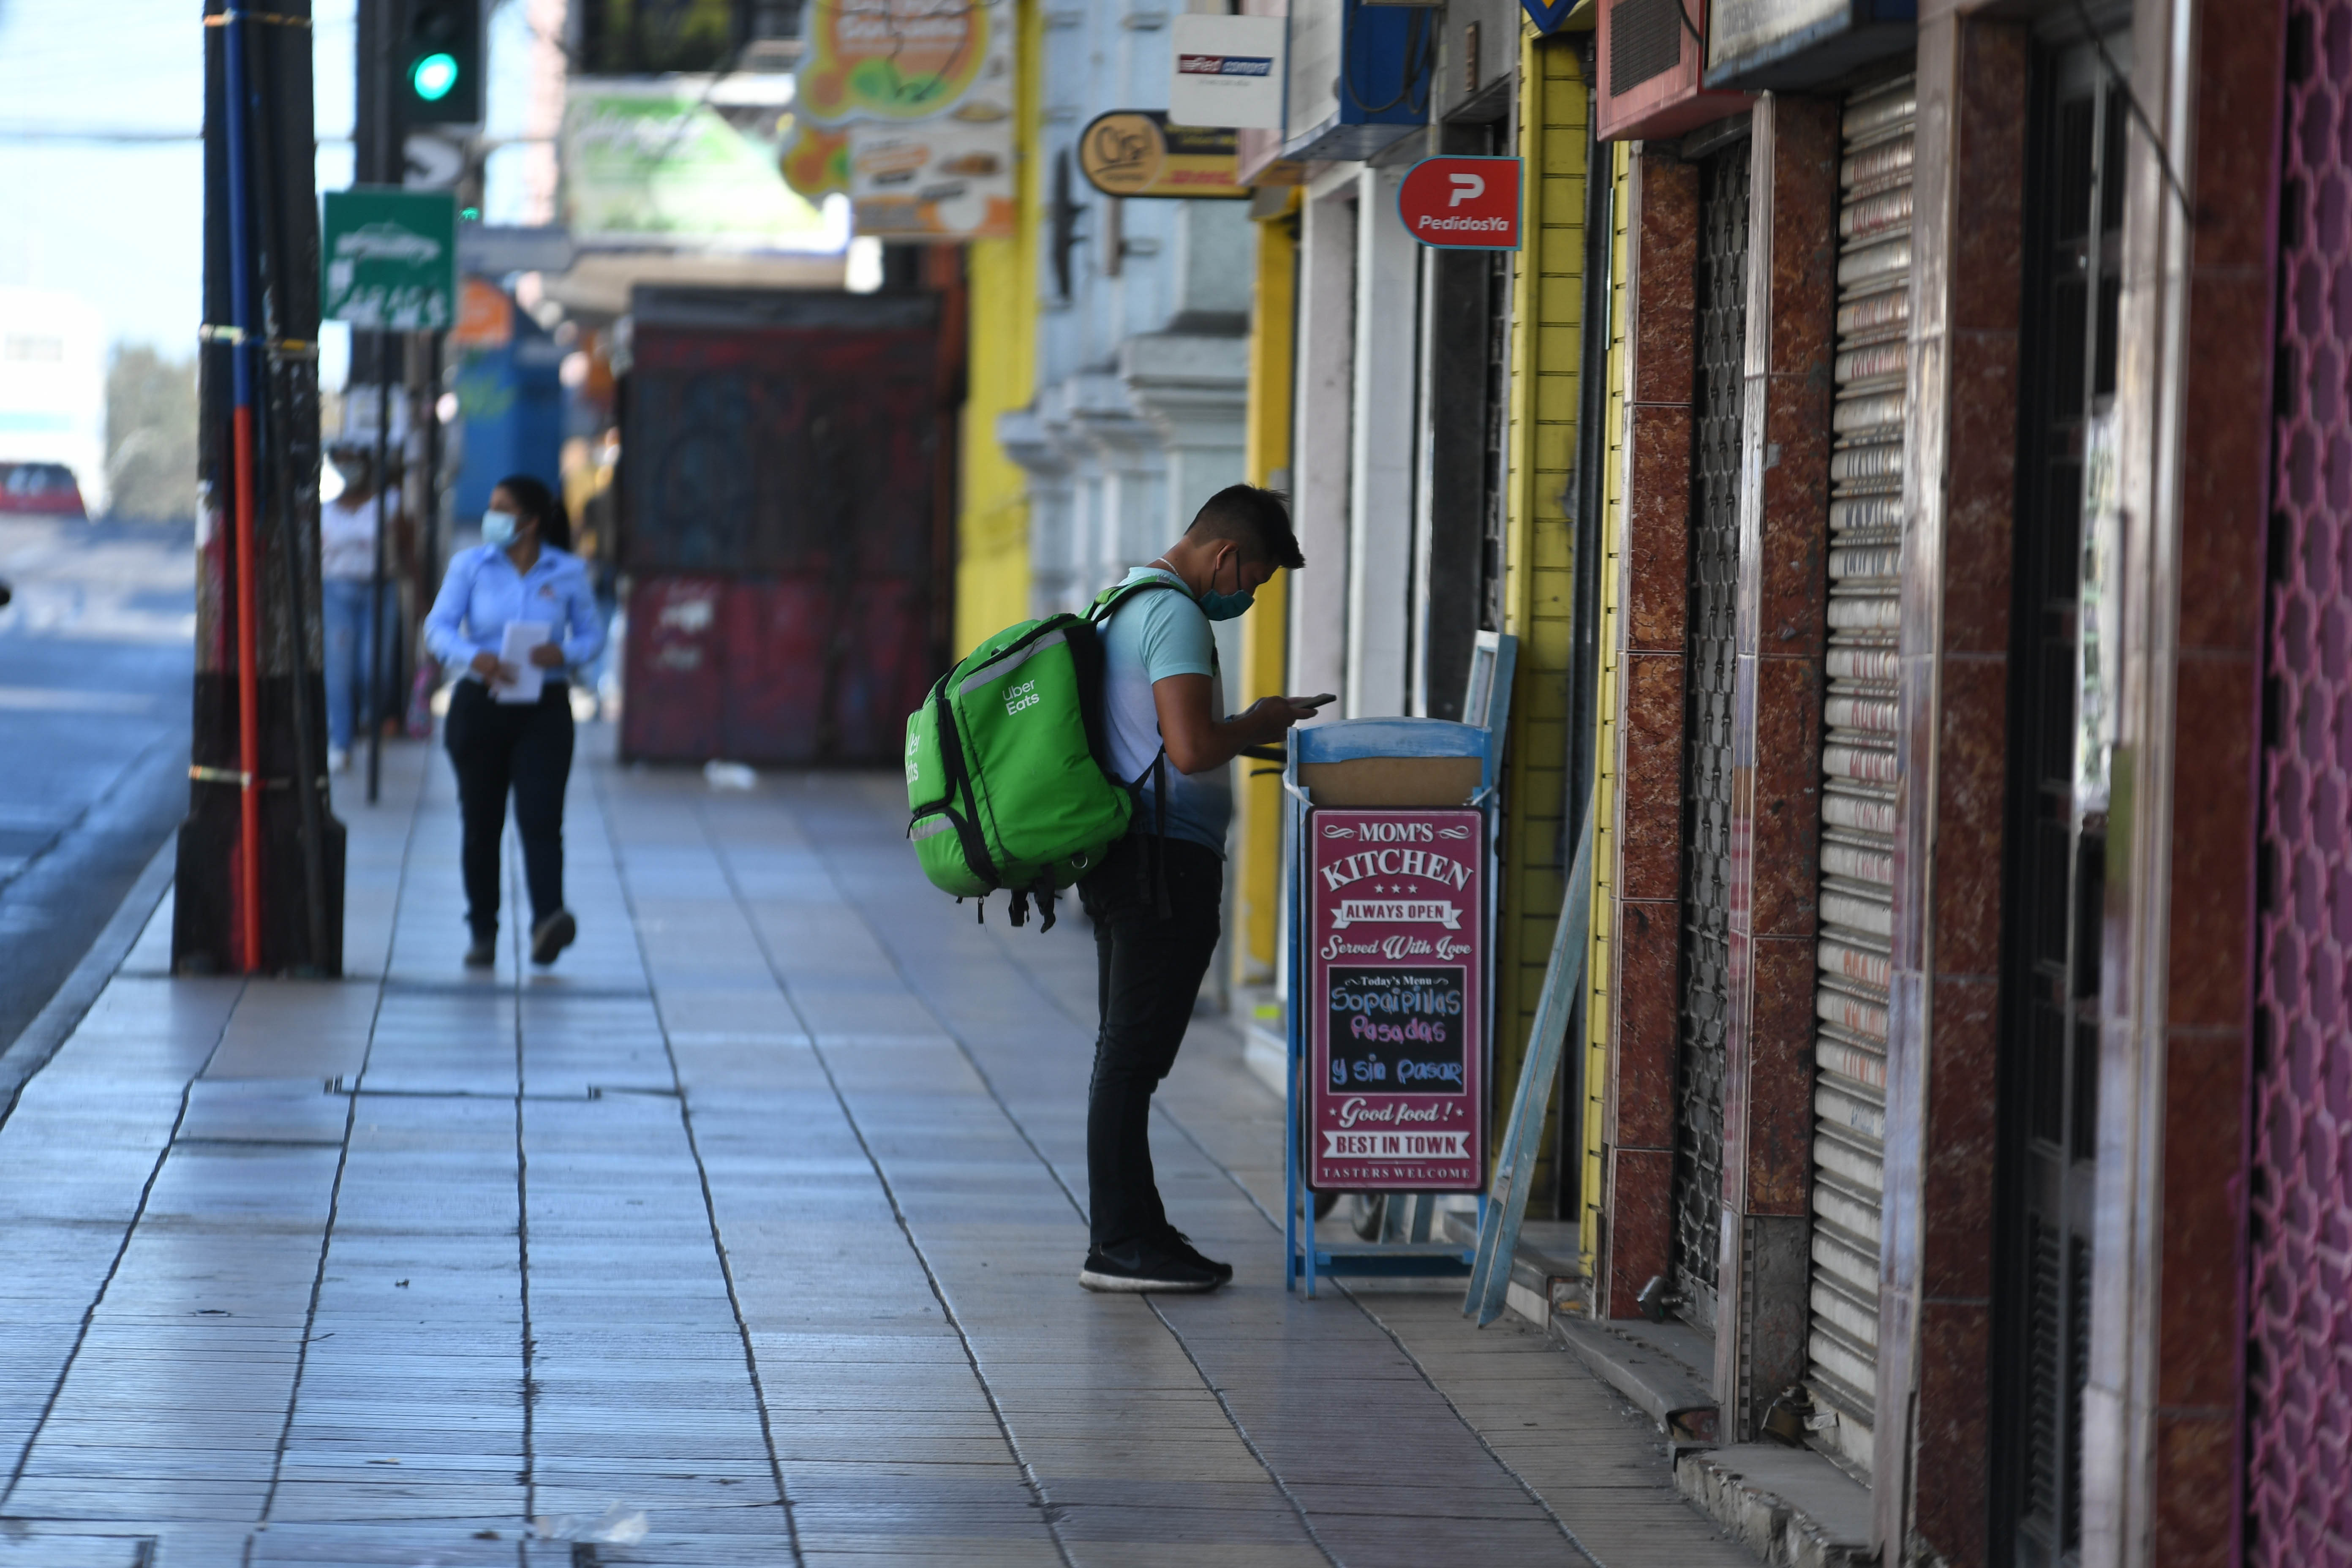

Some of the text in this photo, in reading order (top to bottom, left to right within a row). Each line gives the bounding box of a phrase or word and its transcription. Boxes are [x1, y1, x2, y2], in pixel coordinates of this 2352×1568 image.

[1418, 215, 1509, 231] PedidosYa
[1002, 679, 1034, 701] Uber
[1006, 693, 1040, 716] Eats
[1358, 822, 1434, 842] MOM'S
[1320, 848, 1474, 892] KITCHEN
[1346, 904, 1444, 919] ALWAYS OPEN
[1321, 935, 1472, 961] Served With Love
[1360, 976, 1432, 988] Today's Menu
[1350, 1015, 1446, 1044] Pasadas
[1338, 1097, 1394, 1128] Good
[1336, 1135, 1457, 1154] BEST IN TOWN
[1323, 1168, 1471, 1179] TASTERS WELCOME
